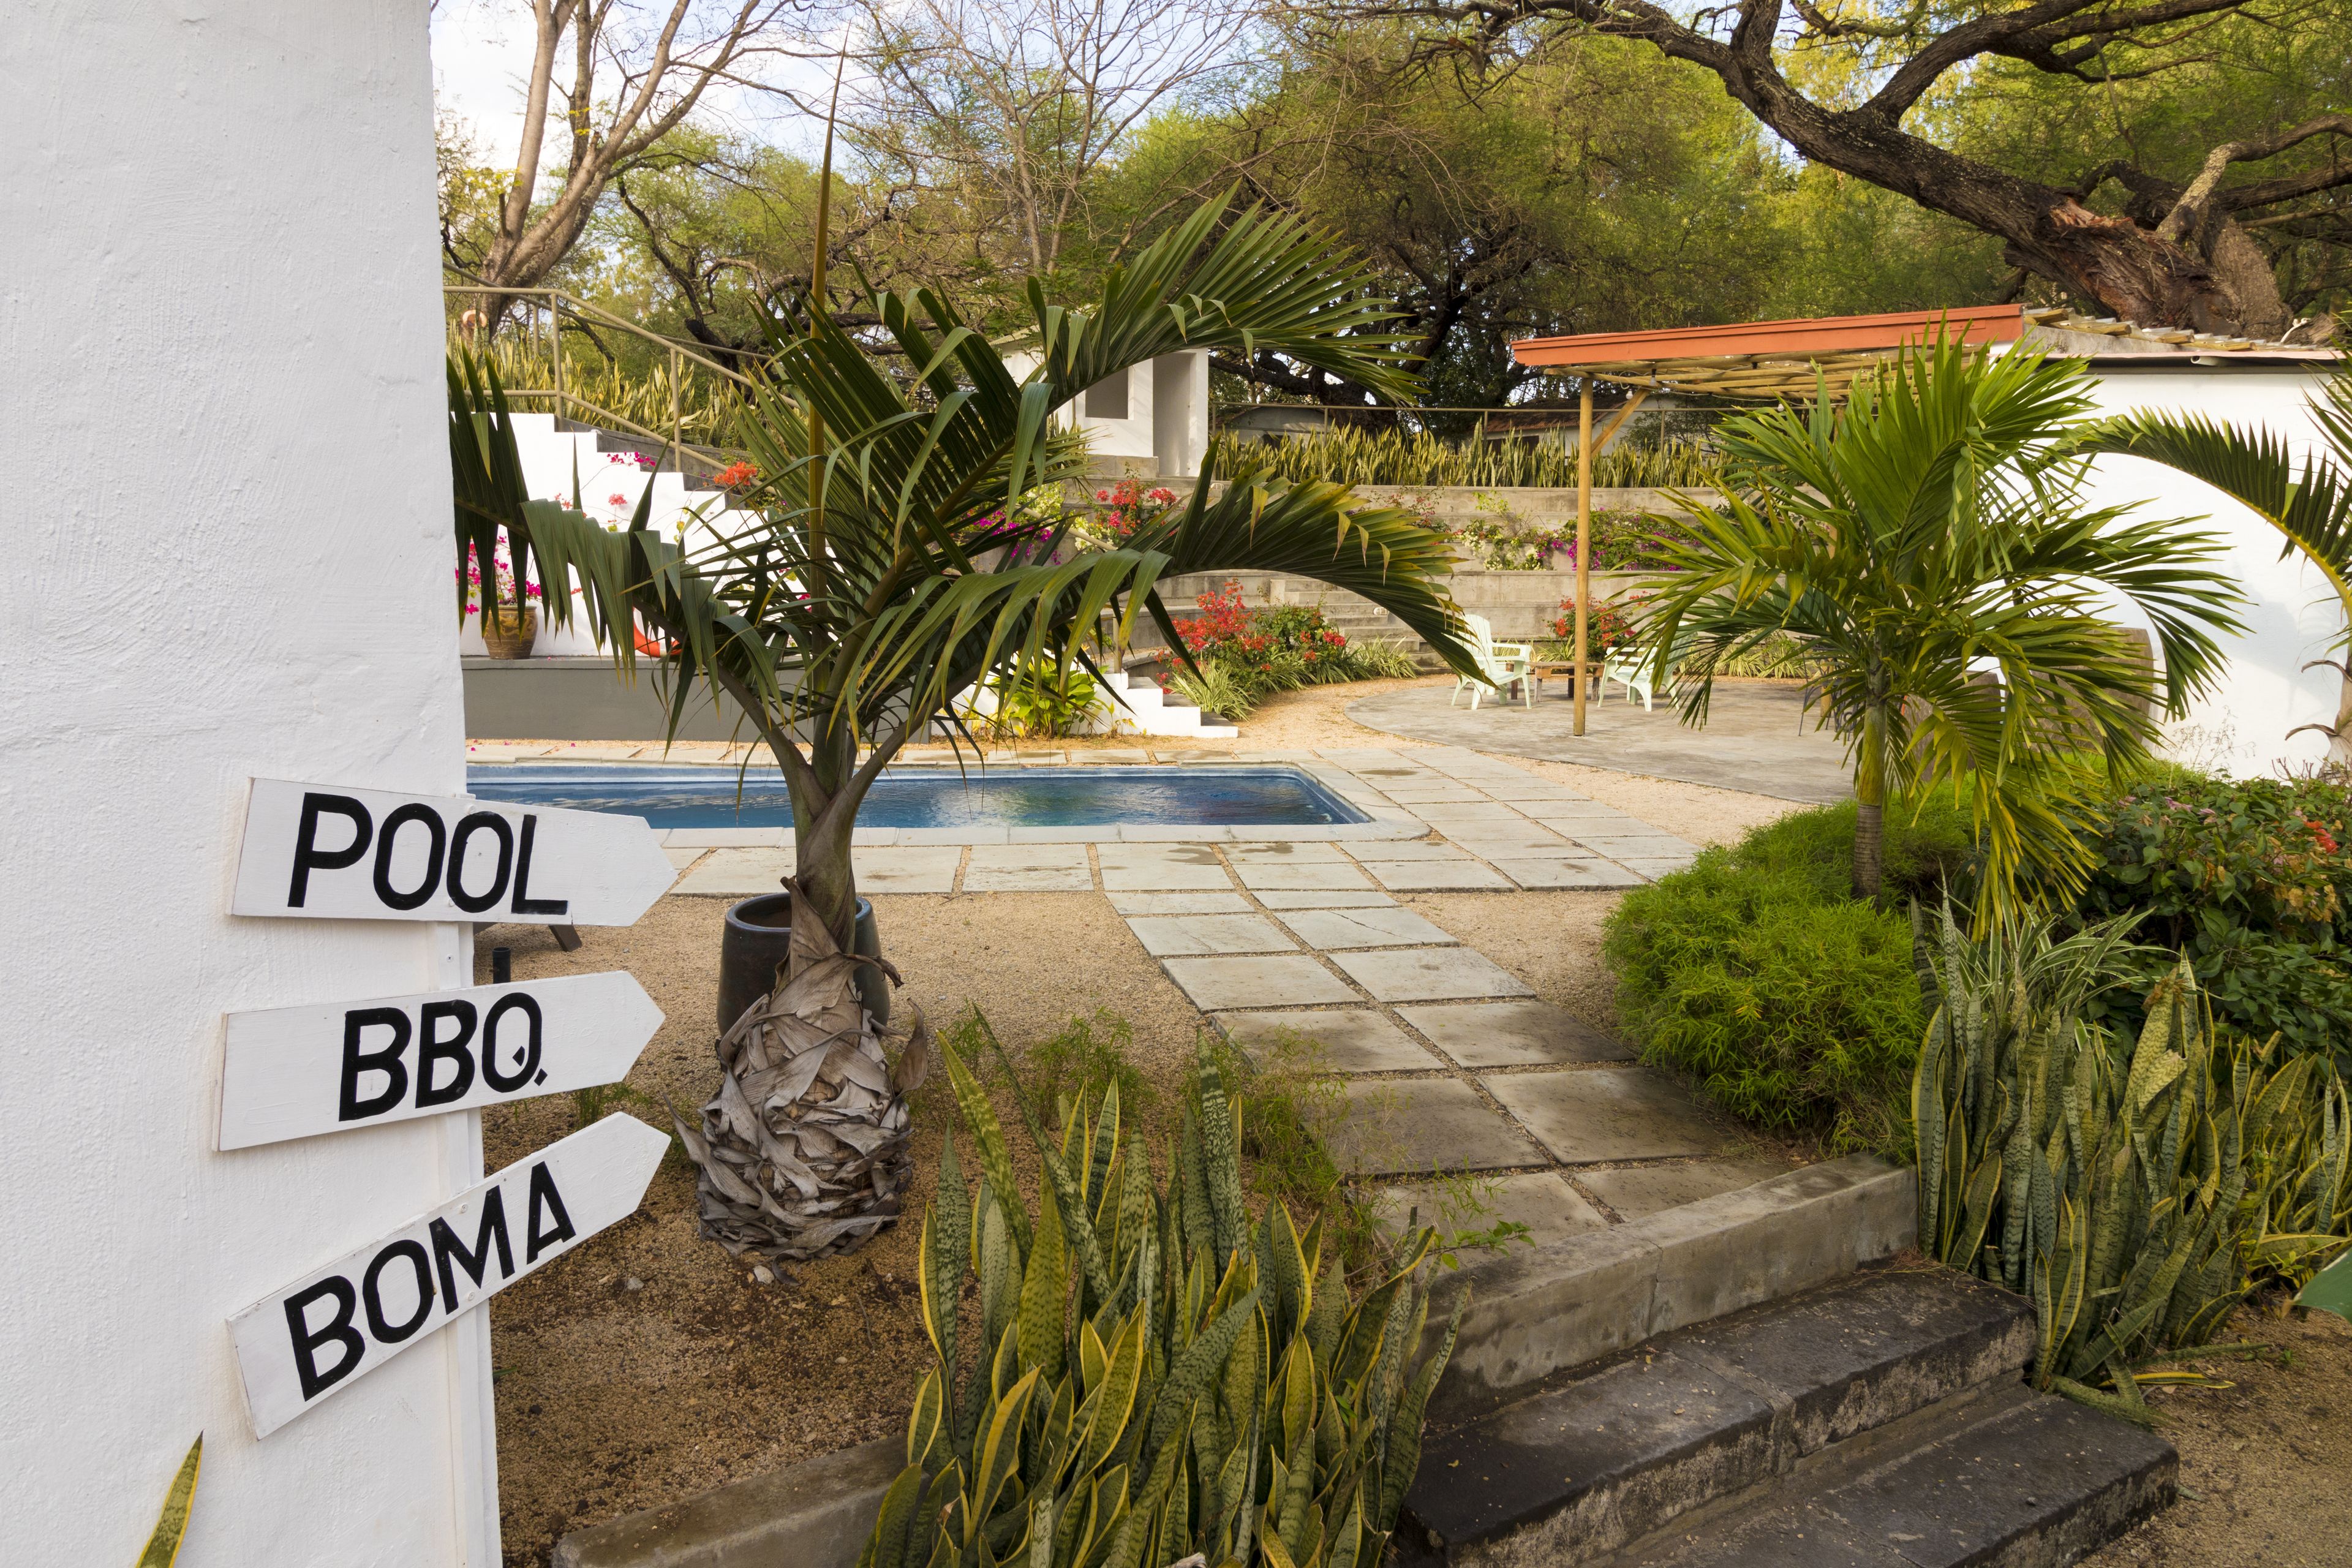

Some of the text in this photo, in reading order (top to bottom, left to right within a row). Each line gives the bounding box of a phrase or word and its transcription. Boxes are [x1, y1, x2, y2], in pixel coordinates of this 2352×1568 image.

[287, 792, 569, 915] POOL
[339, 992, 548, 1122] BBQ
[283, 1161, 576, 1402] BOMA
